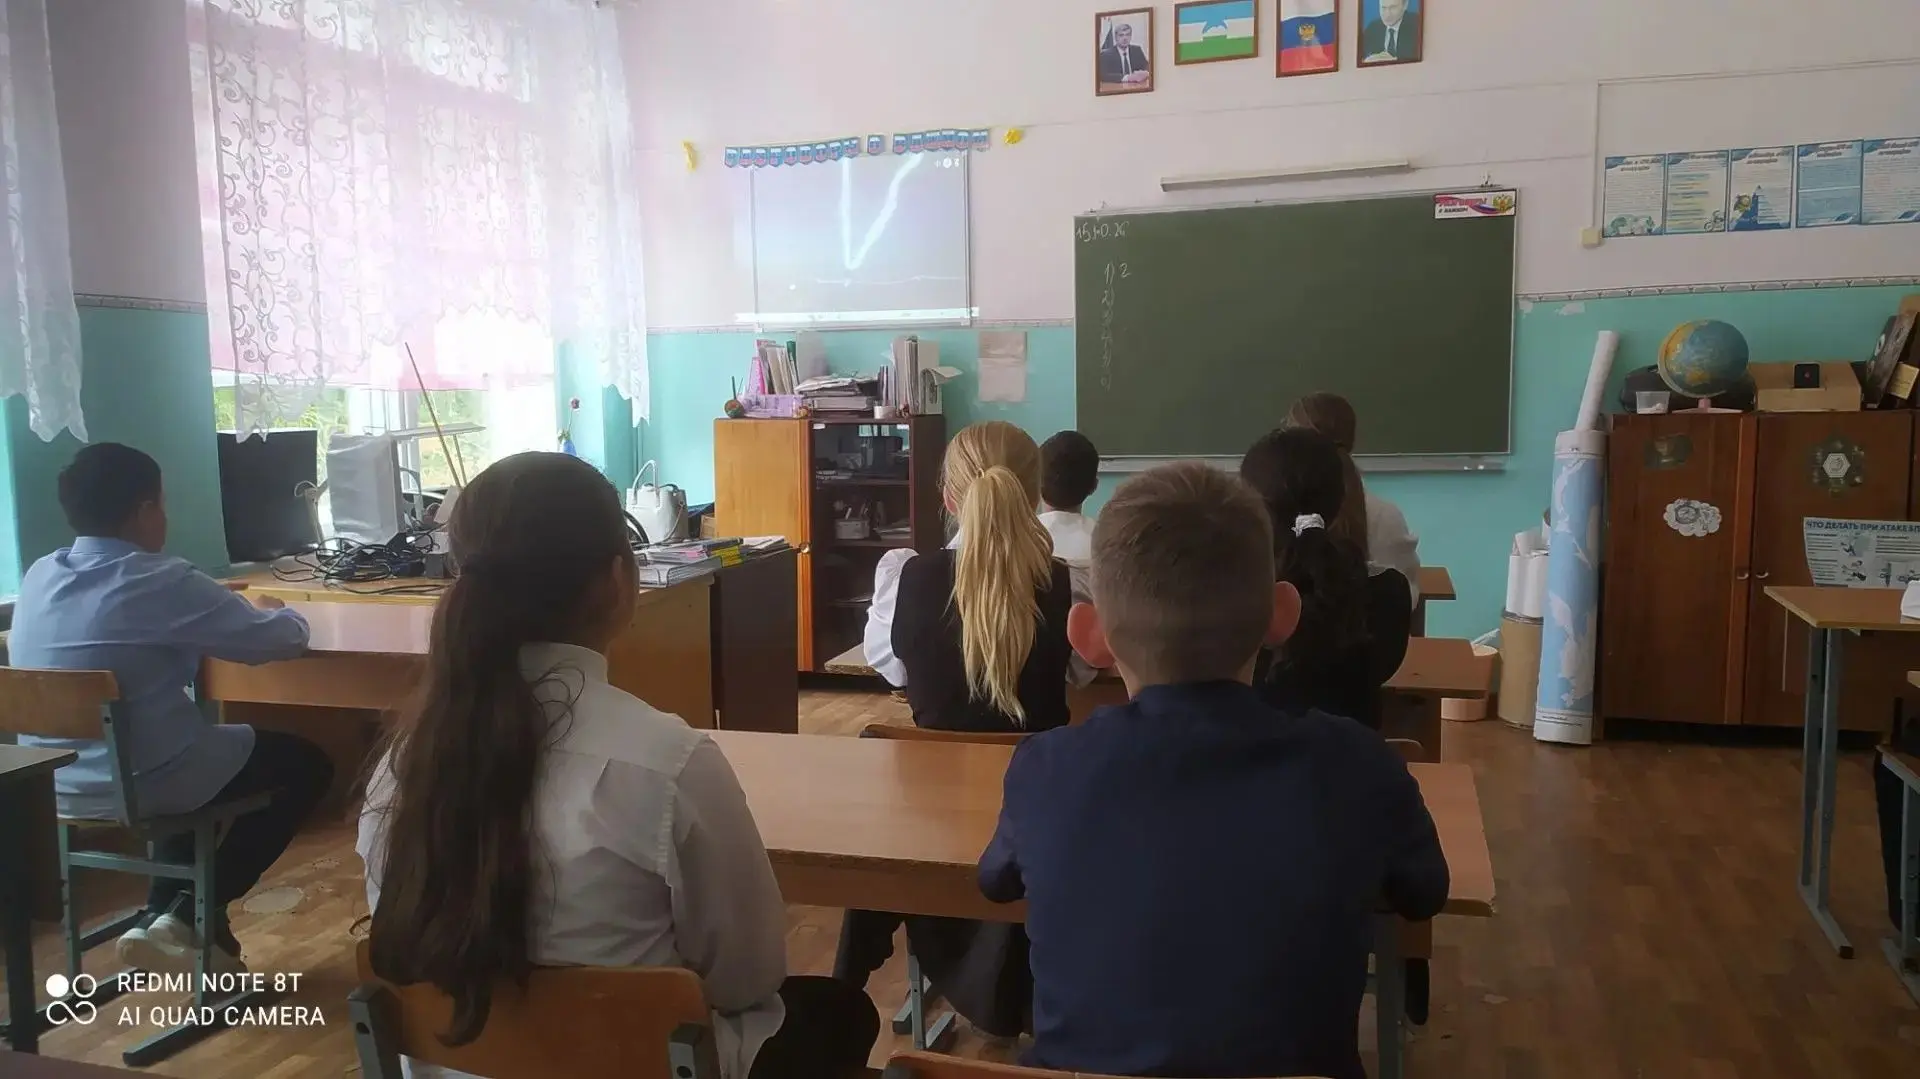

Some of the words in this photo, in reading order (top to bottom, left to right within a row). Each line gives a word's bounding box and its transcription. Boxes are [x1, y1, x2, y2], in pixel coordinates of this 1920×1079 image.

[1806, 521, 1824, 529] ЧТО
[1824, 522, 1858, 531] ДЕЛАТЬ
[1860, 523, 1879, 532] ПРИ
[1880, 524, 1907, 533] АТАКЕ
